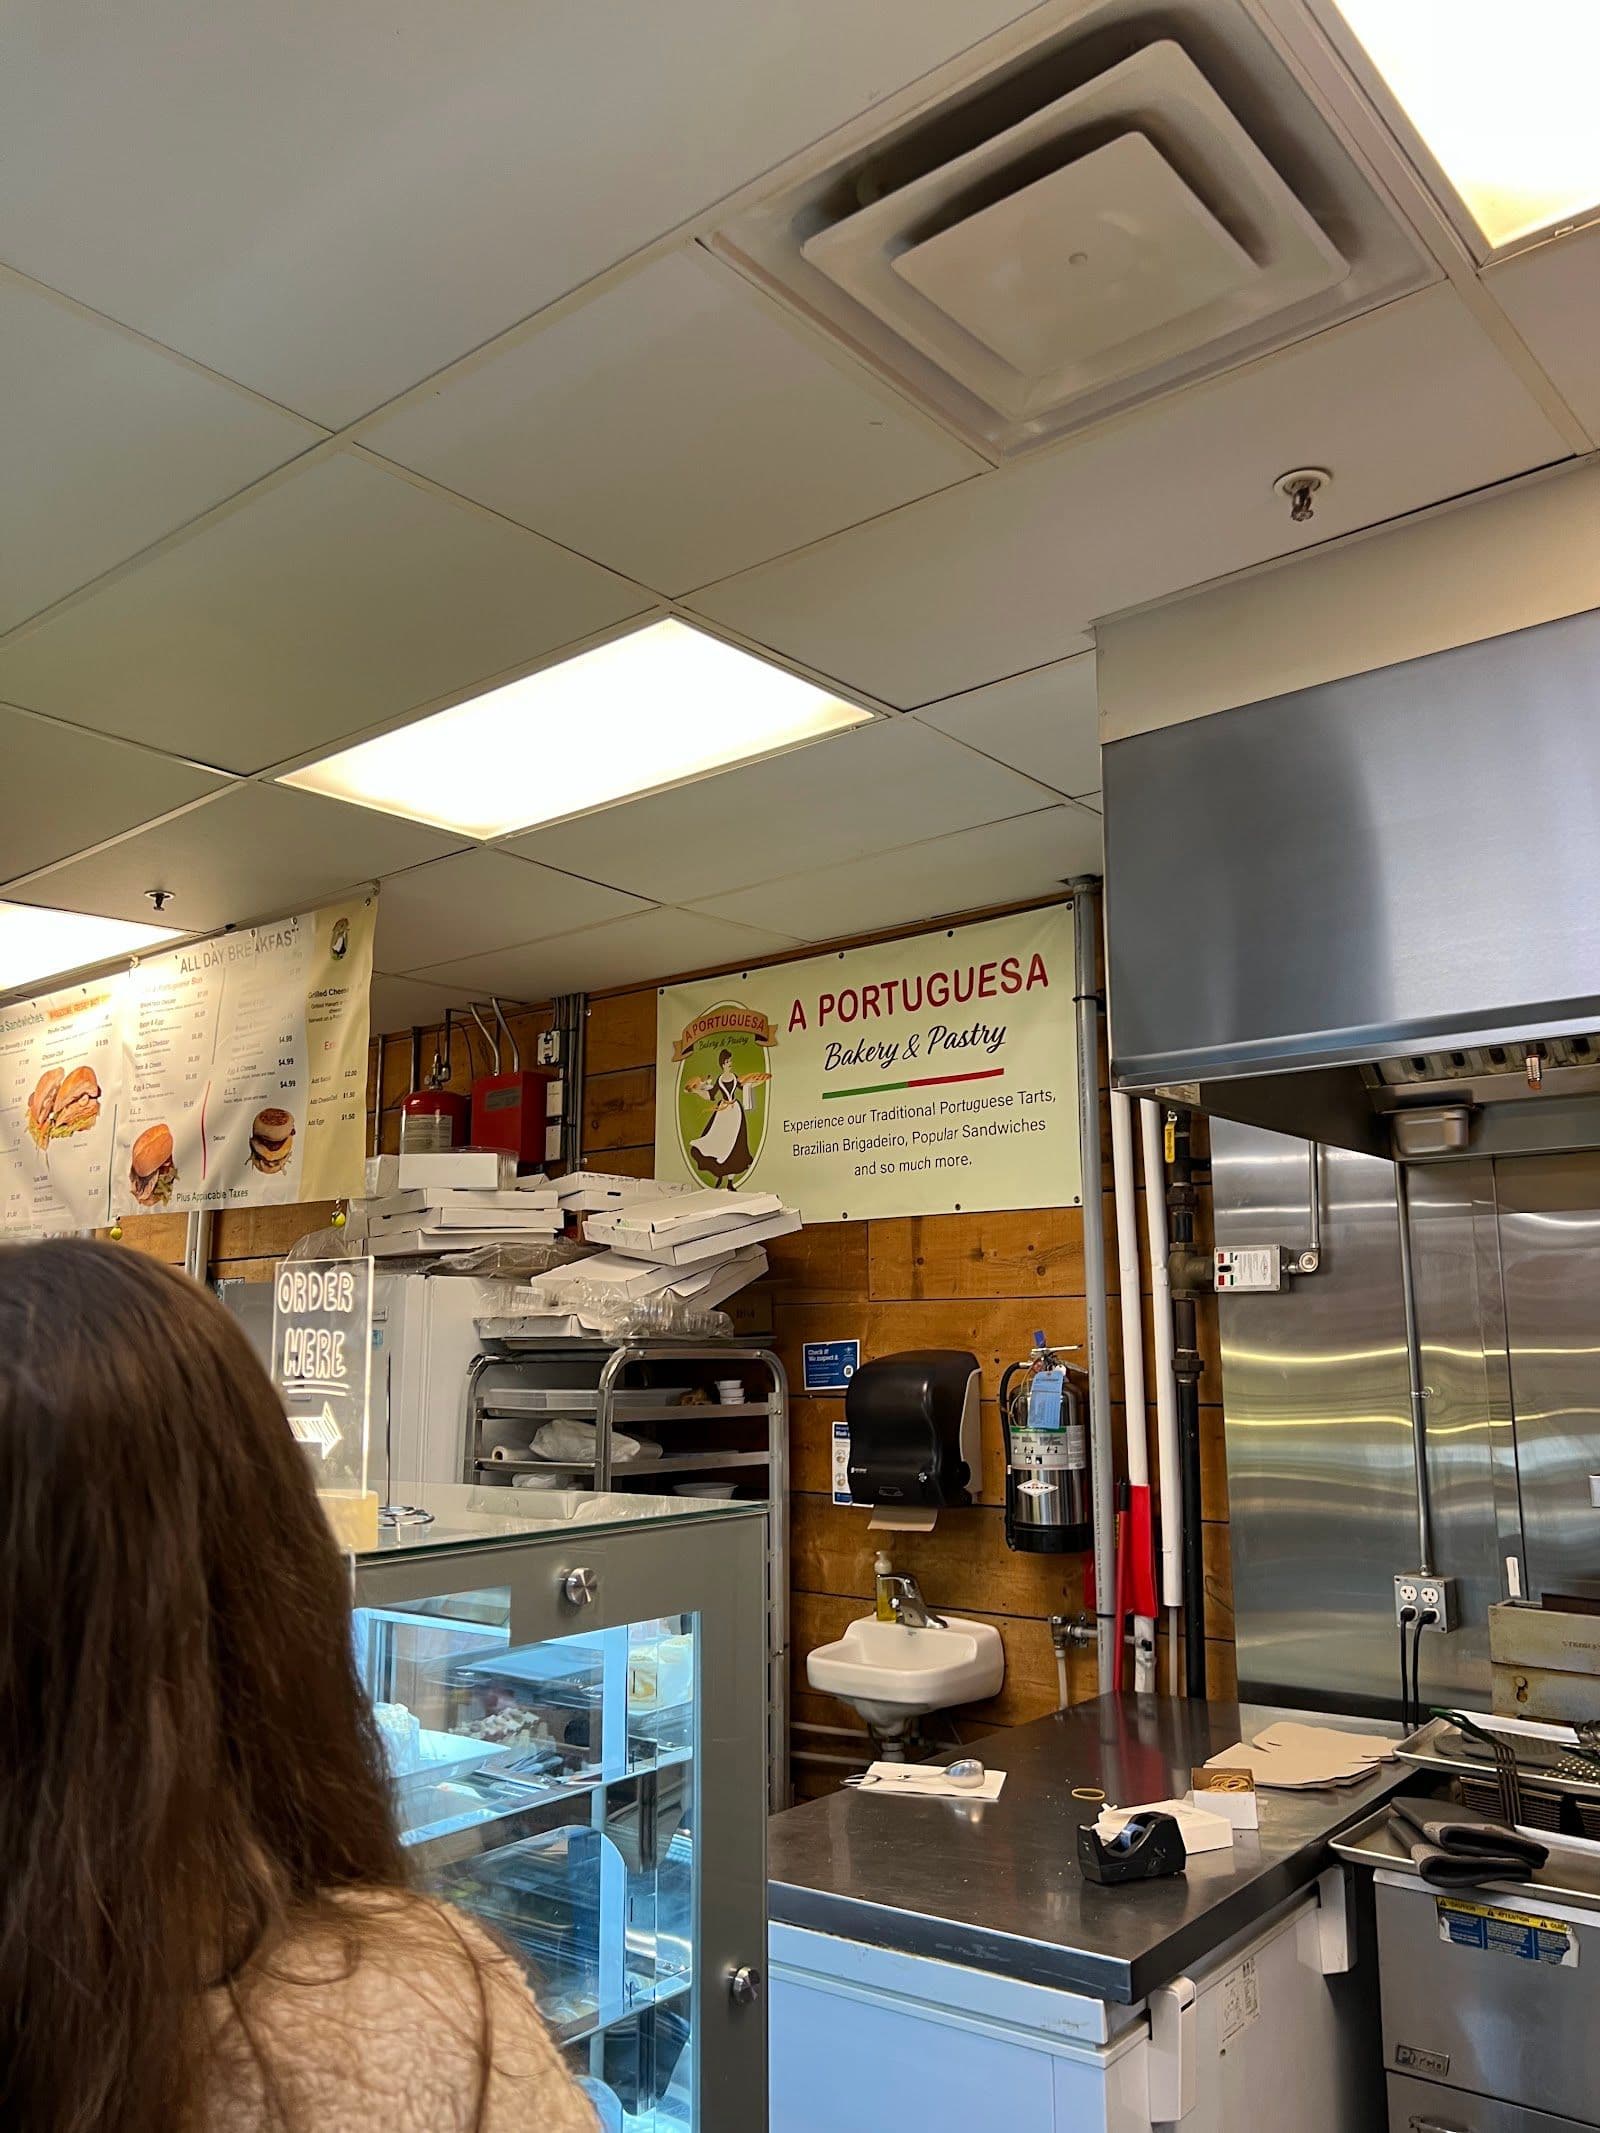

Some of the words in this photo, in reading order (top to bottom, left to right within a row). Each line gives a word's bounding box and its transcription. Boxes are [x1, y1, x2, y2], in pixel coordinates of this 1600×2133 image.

[180, 955, 201, 974] ALL
[203, 946, 225, 968] DAY
[788, 999, 807, 1032] A
[819, 953, 1049, 1027] PORTUGUESA
[685, 1029, 692, 1042] A
[692, 1014, 764, 1036] PORTUGUESA
[278, 1057, 294, 1066] $4.99
[824, 1038, 899, 1071] Bakery
[902, 1033, 920, 1060] &
[927, 1022, 1007, 1055] Pastry
[280, 1080, 296, 1088] $4.99
[783, 1116, 844, 1134] Experience
[847, 1113, 867, 1125] our
[870, 1102, 936, 1122] Traditional
[940, 1095, 1014, 1115] Portuguese
[1016, 1089, 1056, 1105] Tarts,
[792, 1140, 839, 1157] Brazilian
[843, 1133, 908, 1153] Brigadeiro,
[912, 1127, 958, 1146] Popular
[962, 1118, 1046, 1138] Sandwiches
[854, 1161, 876, 1176] and
[880, 1163, 895, 1174] so
[899, 1156, 931, 1172] much
[935, 1155, 972, 1168] more.
[228, 1188, 248, 1198] Taxes
[278, 1271, 353, 1314] ORDER
[283, 1327, 347, 1379] HERE
